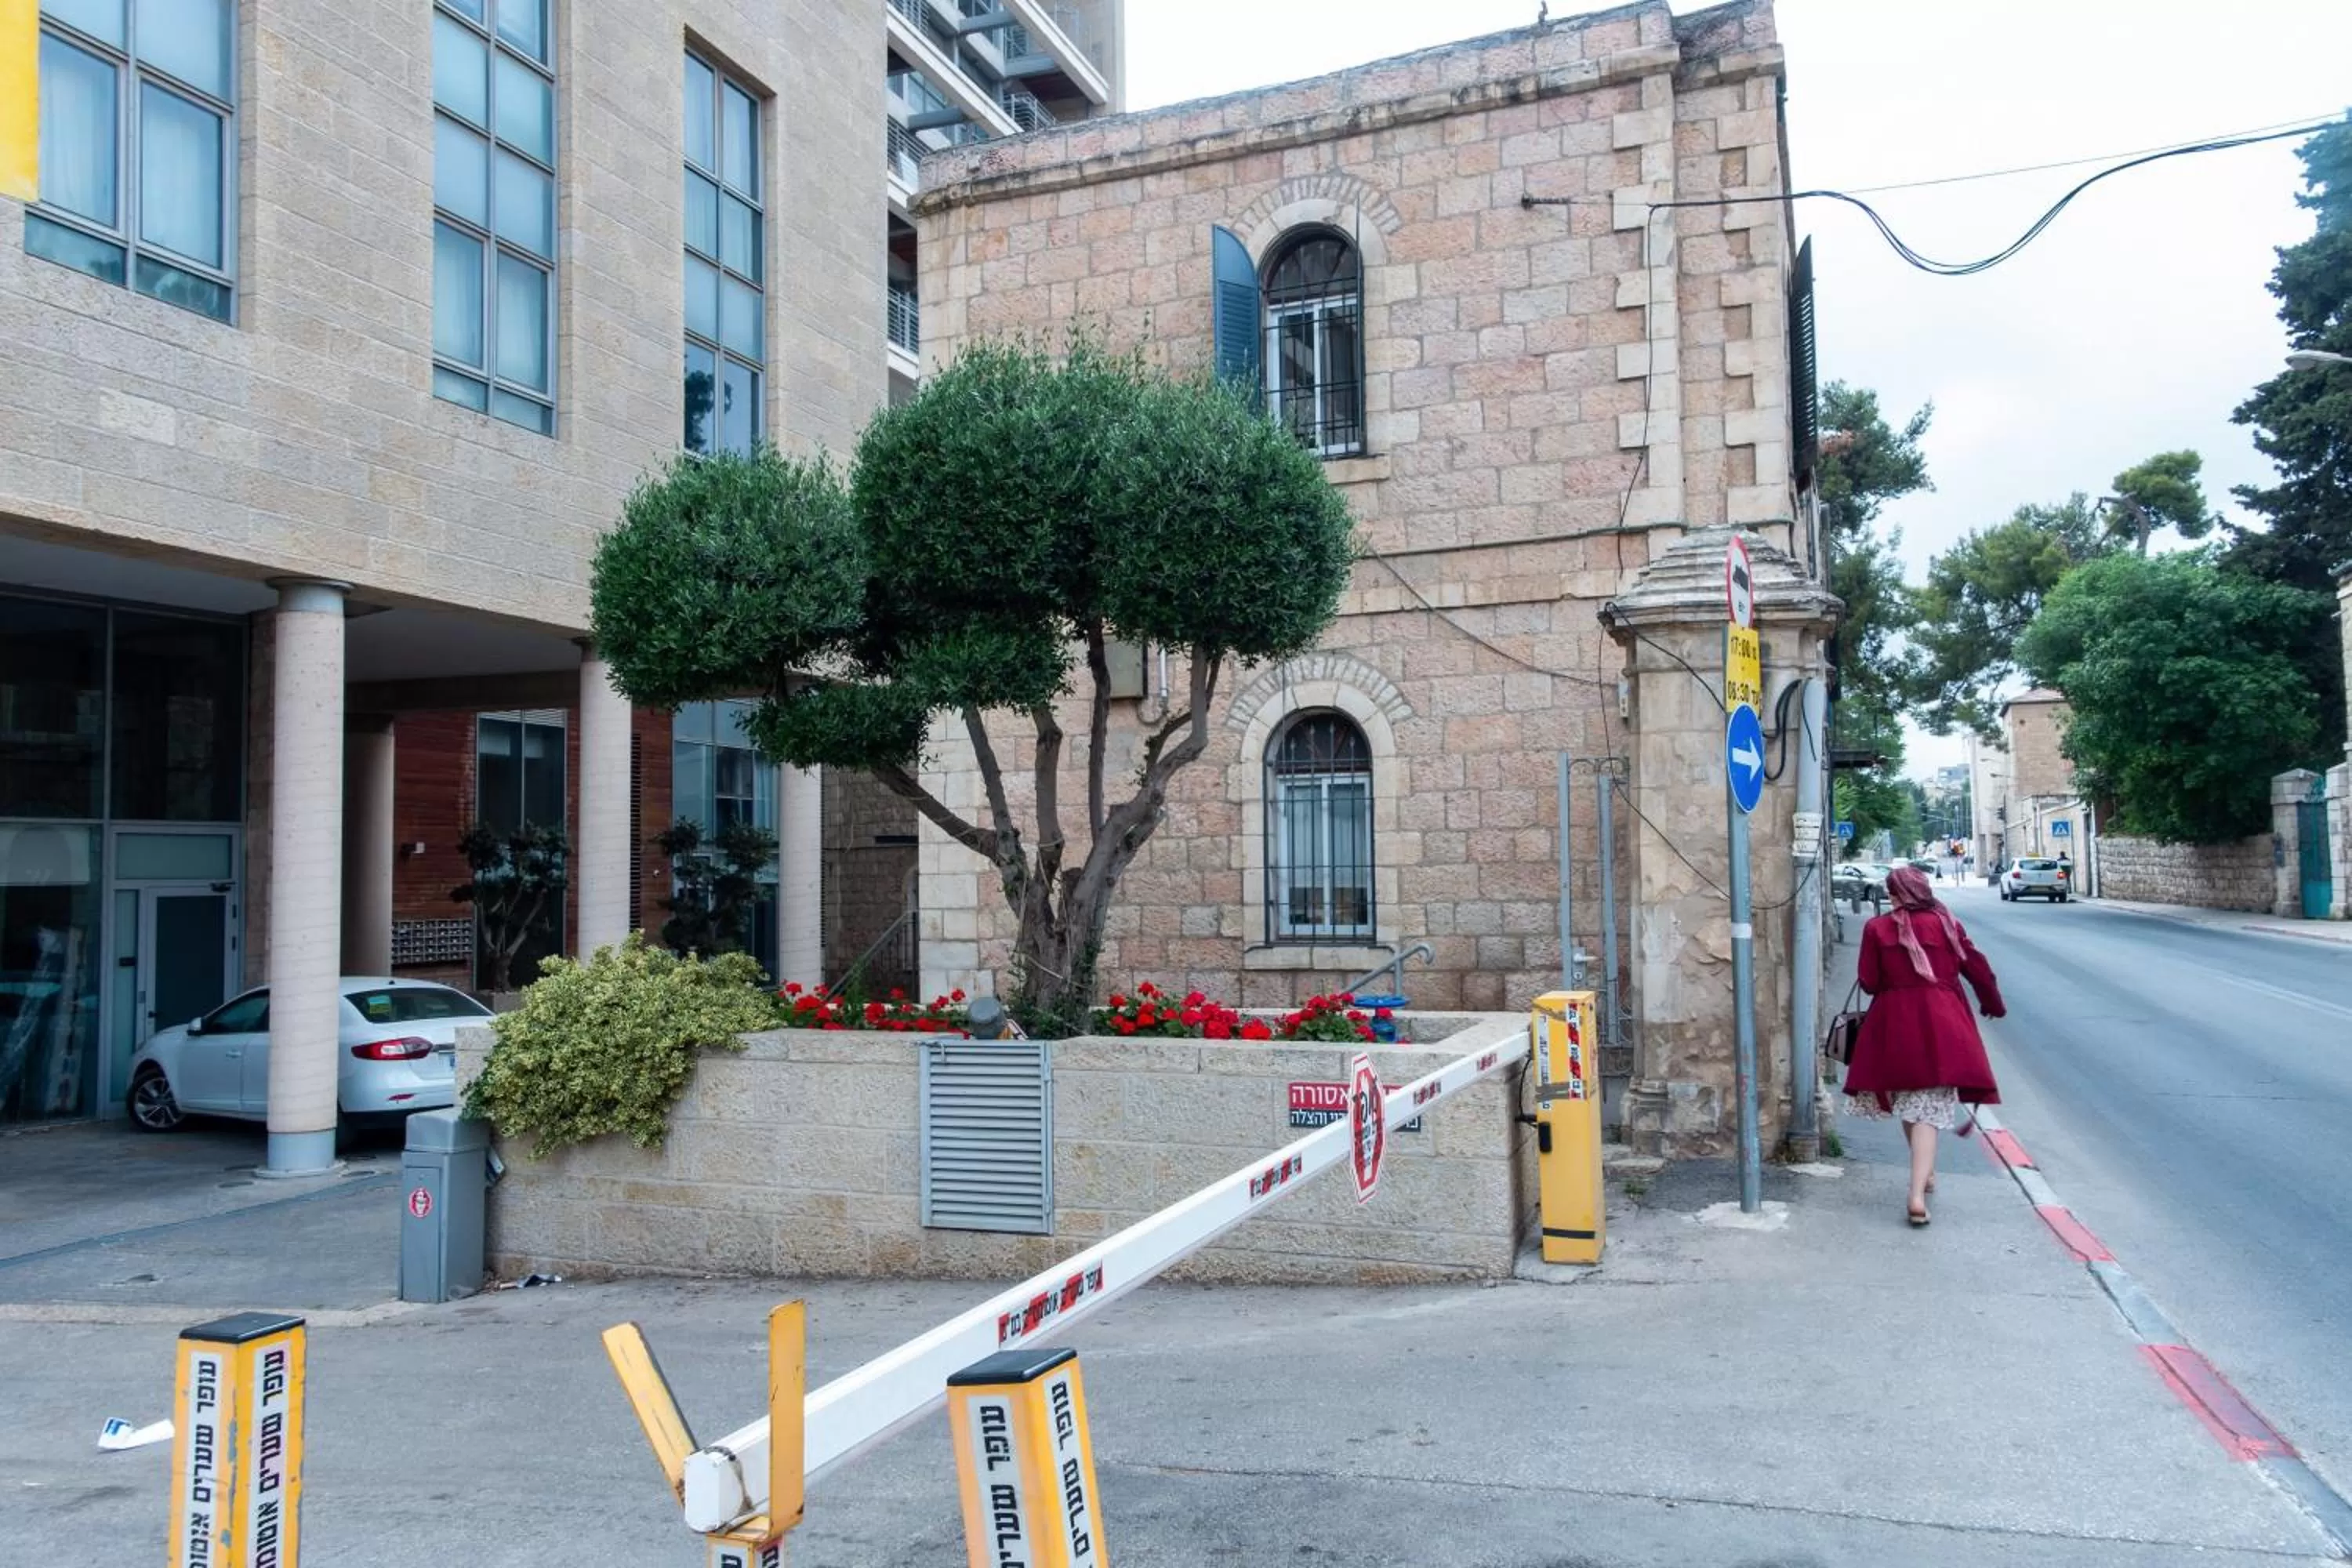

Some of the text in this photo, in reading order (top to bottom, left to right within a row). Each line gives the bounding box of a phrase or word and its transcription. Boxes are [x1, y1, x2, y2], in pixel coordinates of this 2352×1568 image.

[1291, 1086, 1350, 1105] אסורה
[1291, 1108, 1327, 1124] והצלה
[197, 1359, 216, 1414] עופר
[193, 1424, 214, 1503] שערים
[255, 1349, 285, 1568] עופר שערים אוטומ
[979, 1405, 1011, 1472] עופר
[1051, 1380, 1091, 1559] עופר שערים
